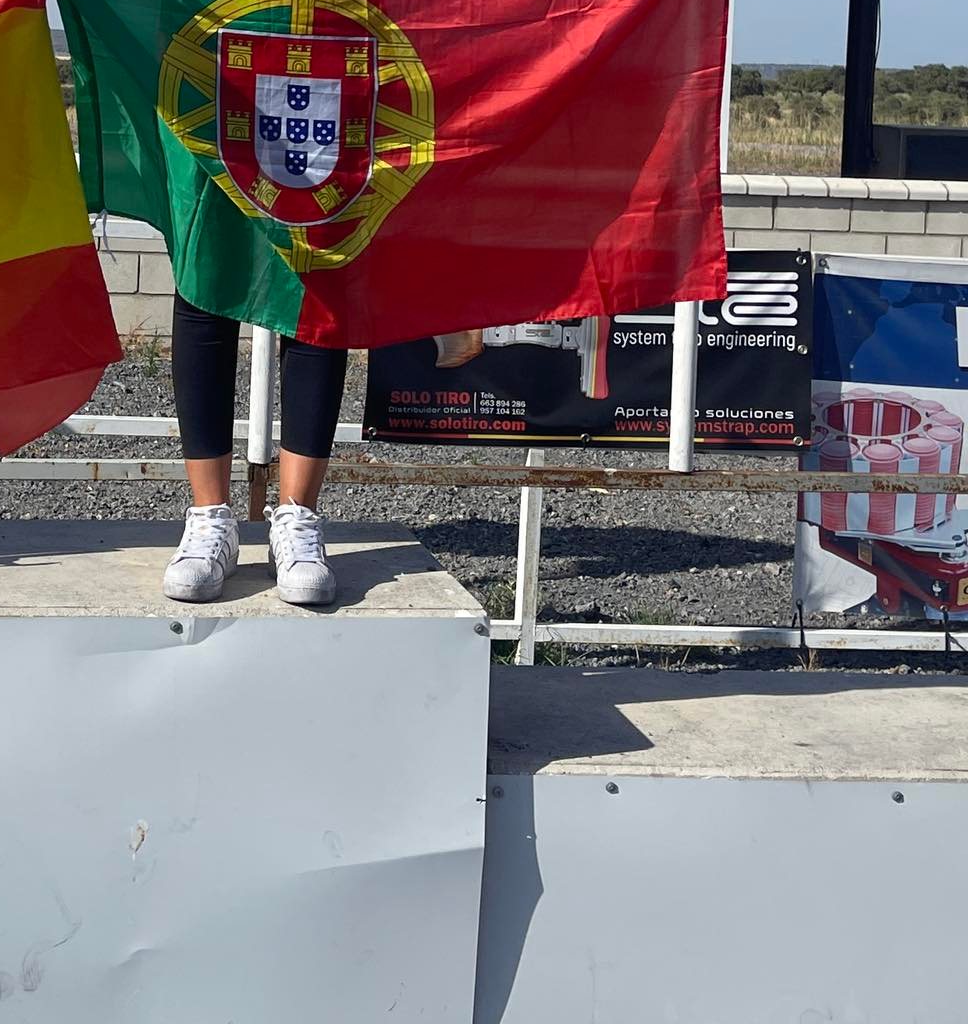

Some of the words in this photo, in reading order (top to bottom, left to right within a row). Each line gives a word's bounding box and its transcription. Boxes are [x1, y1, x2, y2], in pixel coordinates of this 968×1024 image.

[613, 330, 666, 348] system
[707, 330, 796, 352] engineering
[390, 390, 431, 404] SOLO
[435, 391, 471, 405] TIRO
[388, 406, 441, 414] Distribuidor
[614, 406, 699, 419] Aportao
[706, 407, 794, 420] soluciones
[388, 417, 526, 431] www.solotiro.com
[615, 420, 794, 434] www.symstrap.com
